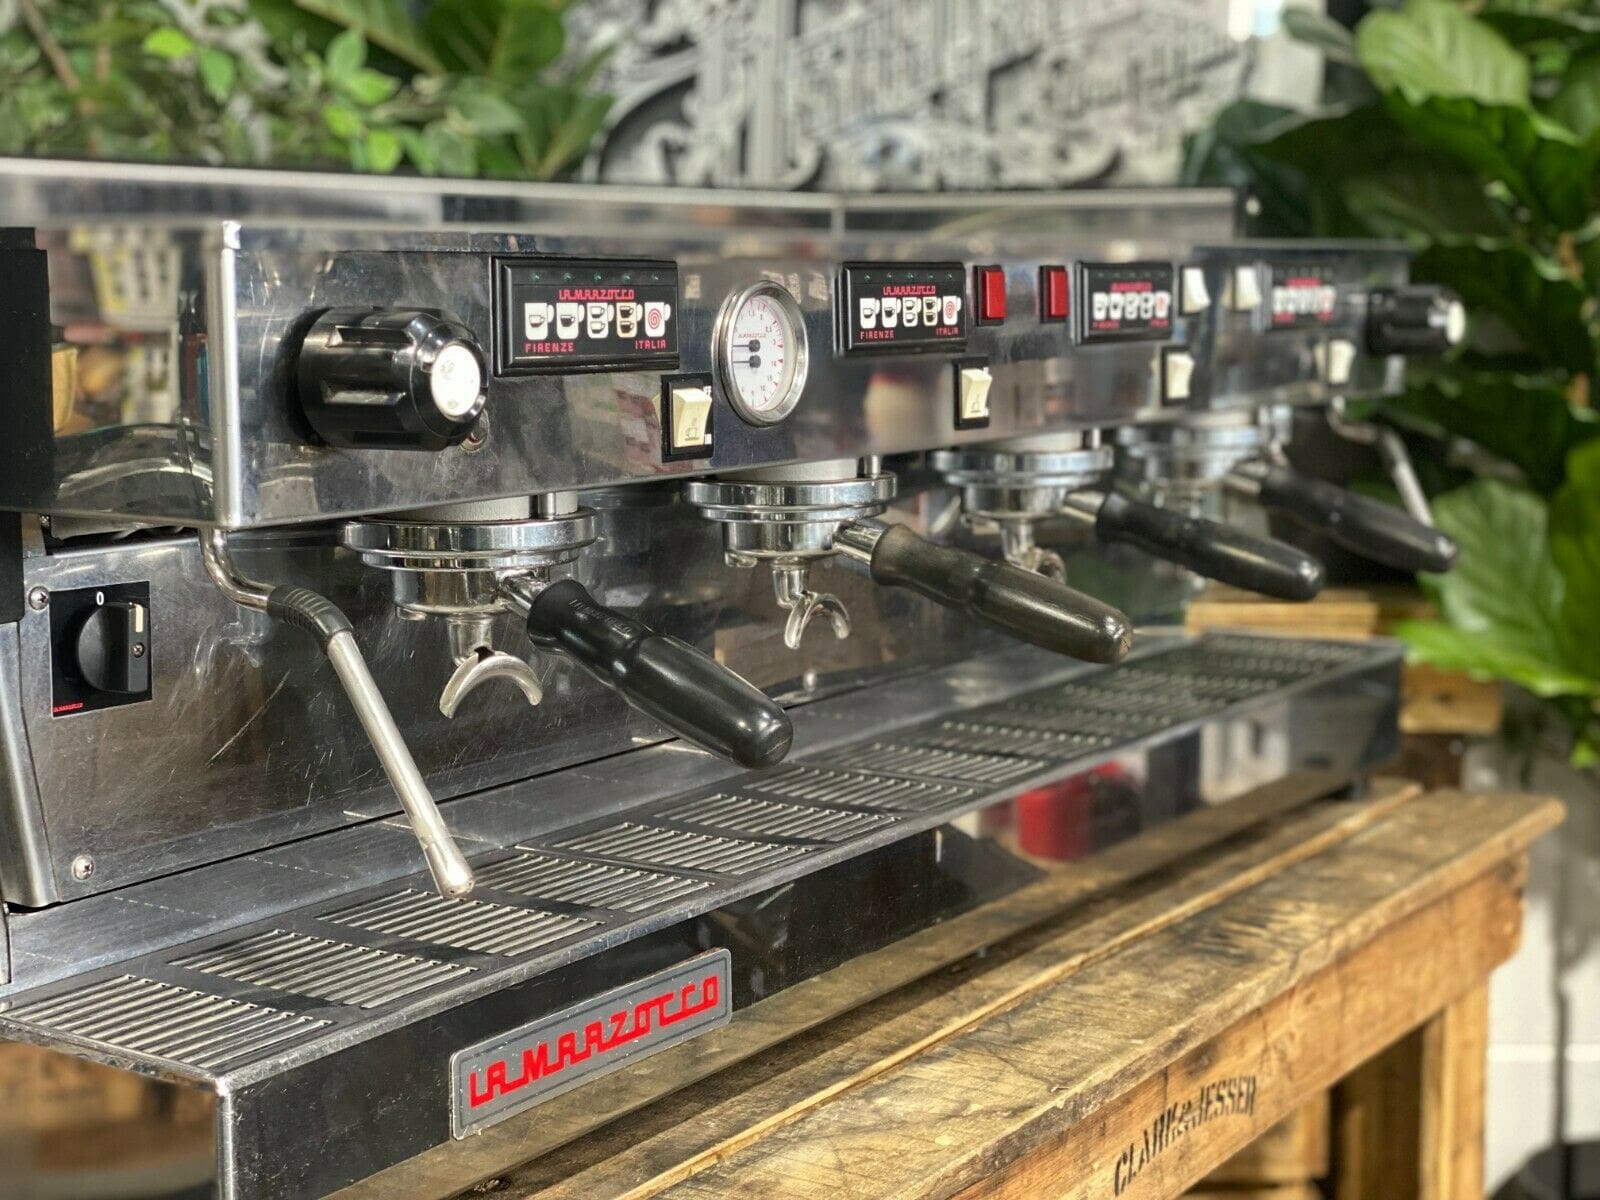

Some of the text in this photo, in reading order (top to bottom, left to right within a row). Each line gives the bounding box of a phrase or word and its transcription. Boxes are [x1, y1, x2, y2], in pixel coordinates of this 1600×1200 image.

[860, 330, 894, 339] FIRENZE
[525, 339, 667, 353] FIRENZE ITALIA
